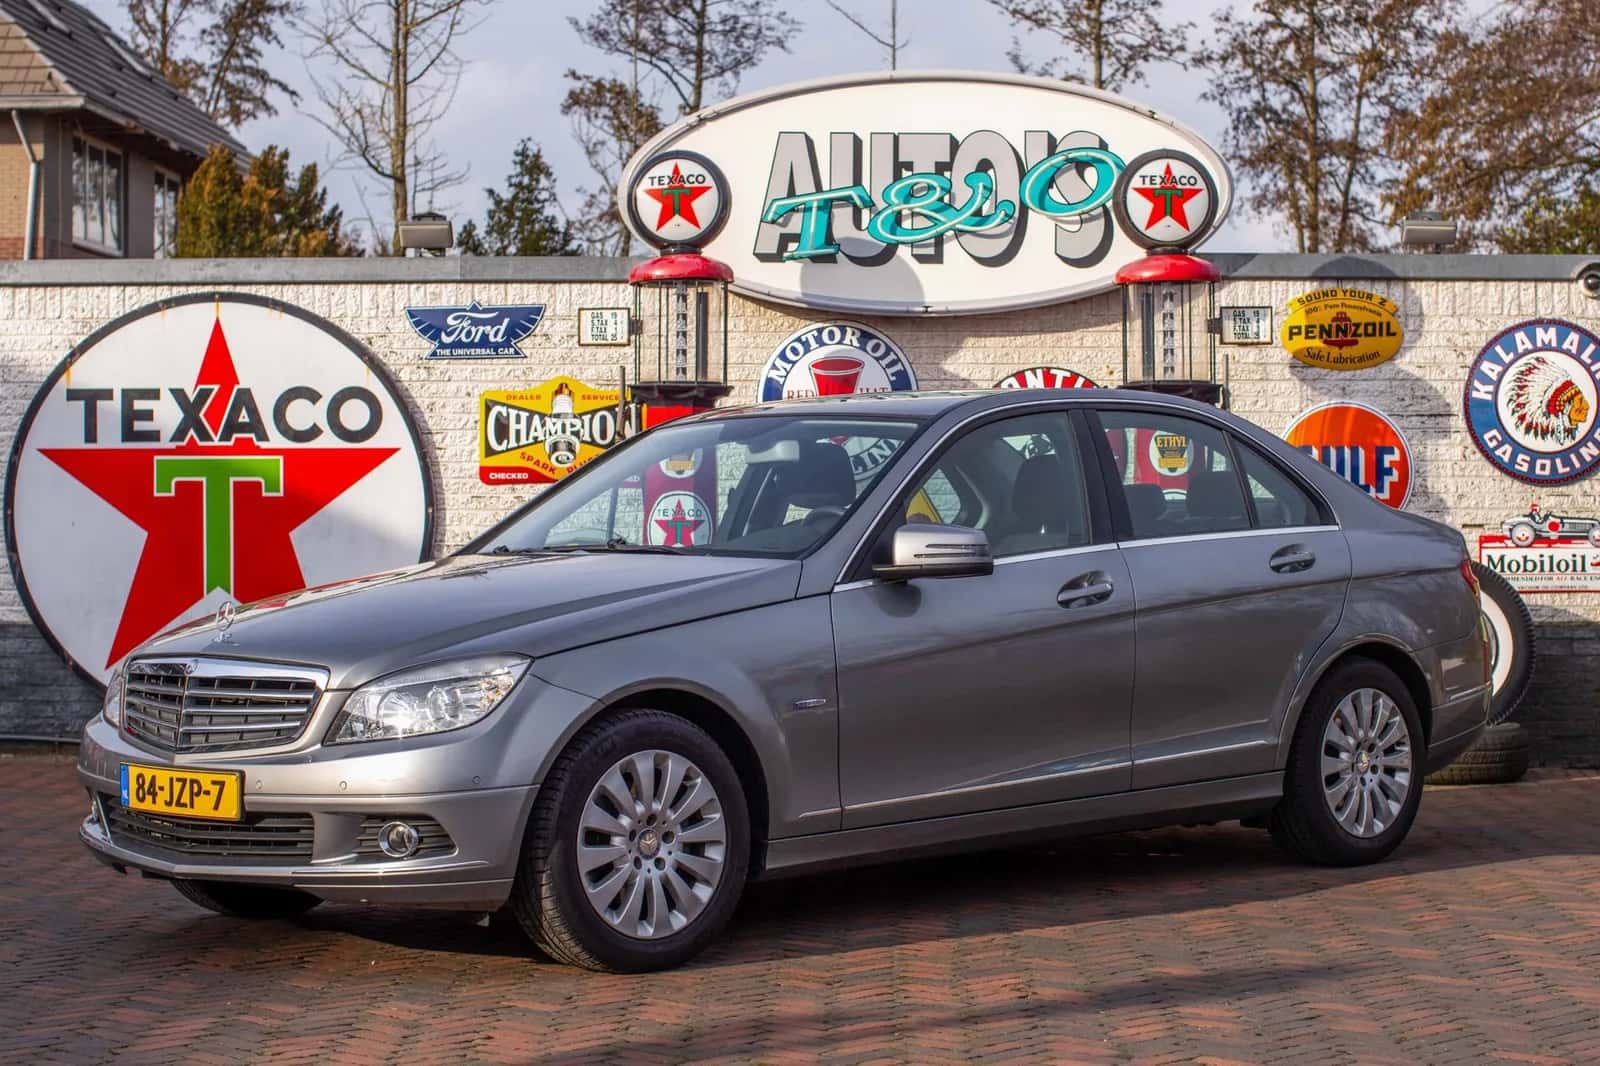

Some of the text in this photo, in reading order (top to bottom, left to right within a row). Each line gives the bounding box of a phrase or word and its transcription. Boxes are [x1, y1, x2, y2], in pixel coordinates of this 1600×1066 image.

[648, 174, 706, 186] TEXACO
[1139, 174, 1198, 187] TEXACO
[1297, 289, 1338, 306] SOUND
[1342, 289, 1374, 301] YOUR
[441, 312, 510, 343] Ford
[1288, 321, 1398, 341] PENNZOIL
[437, 347, 515, 356] THE UNIVERSAL CAR
[768, 326, 904, 384] MOTOR OIL
[1304, 347, 1382, 365] Safe Lubrication
[787, 389, 815, 400] RED
[66, 385, 384, 444] TEXACO
[1157, 436, 1187, 448] ETHYL
[519, 451, 556, 475] SPARK
[489, 472, 529, 480] CHECKED
[658, 508, 703, 518] TEXACO
[1486, 554, 1587, 574] Mobiloil
[135, 772, 226, 811] 84-JZP-7
